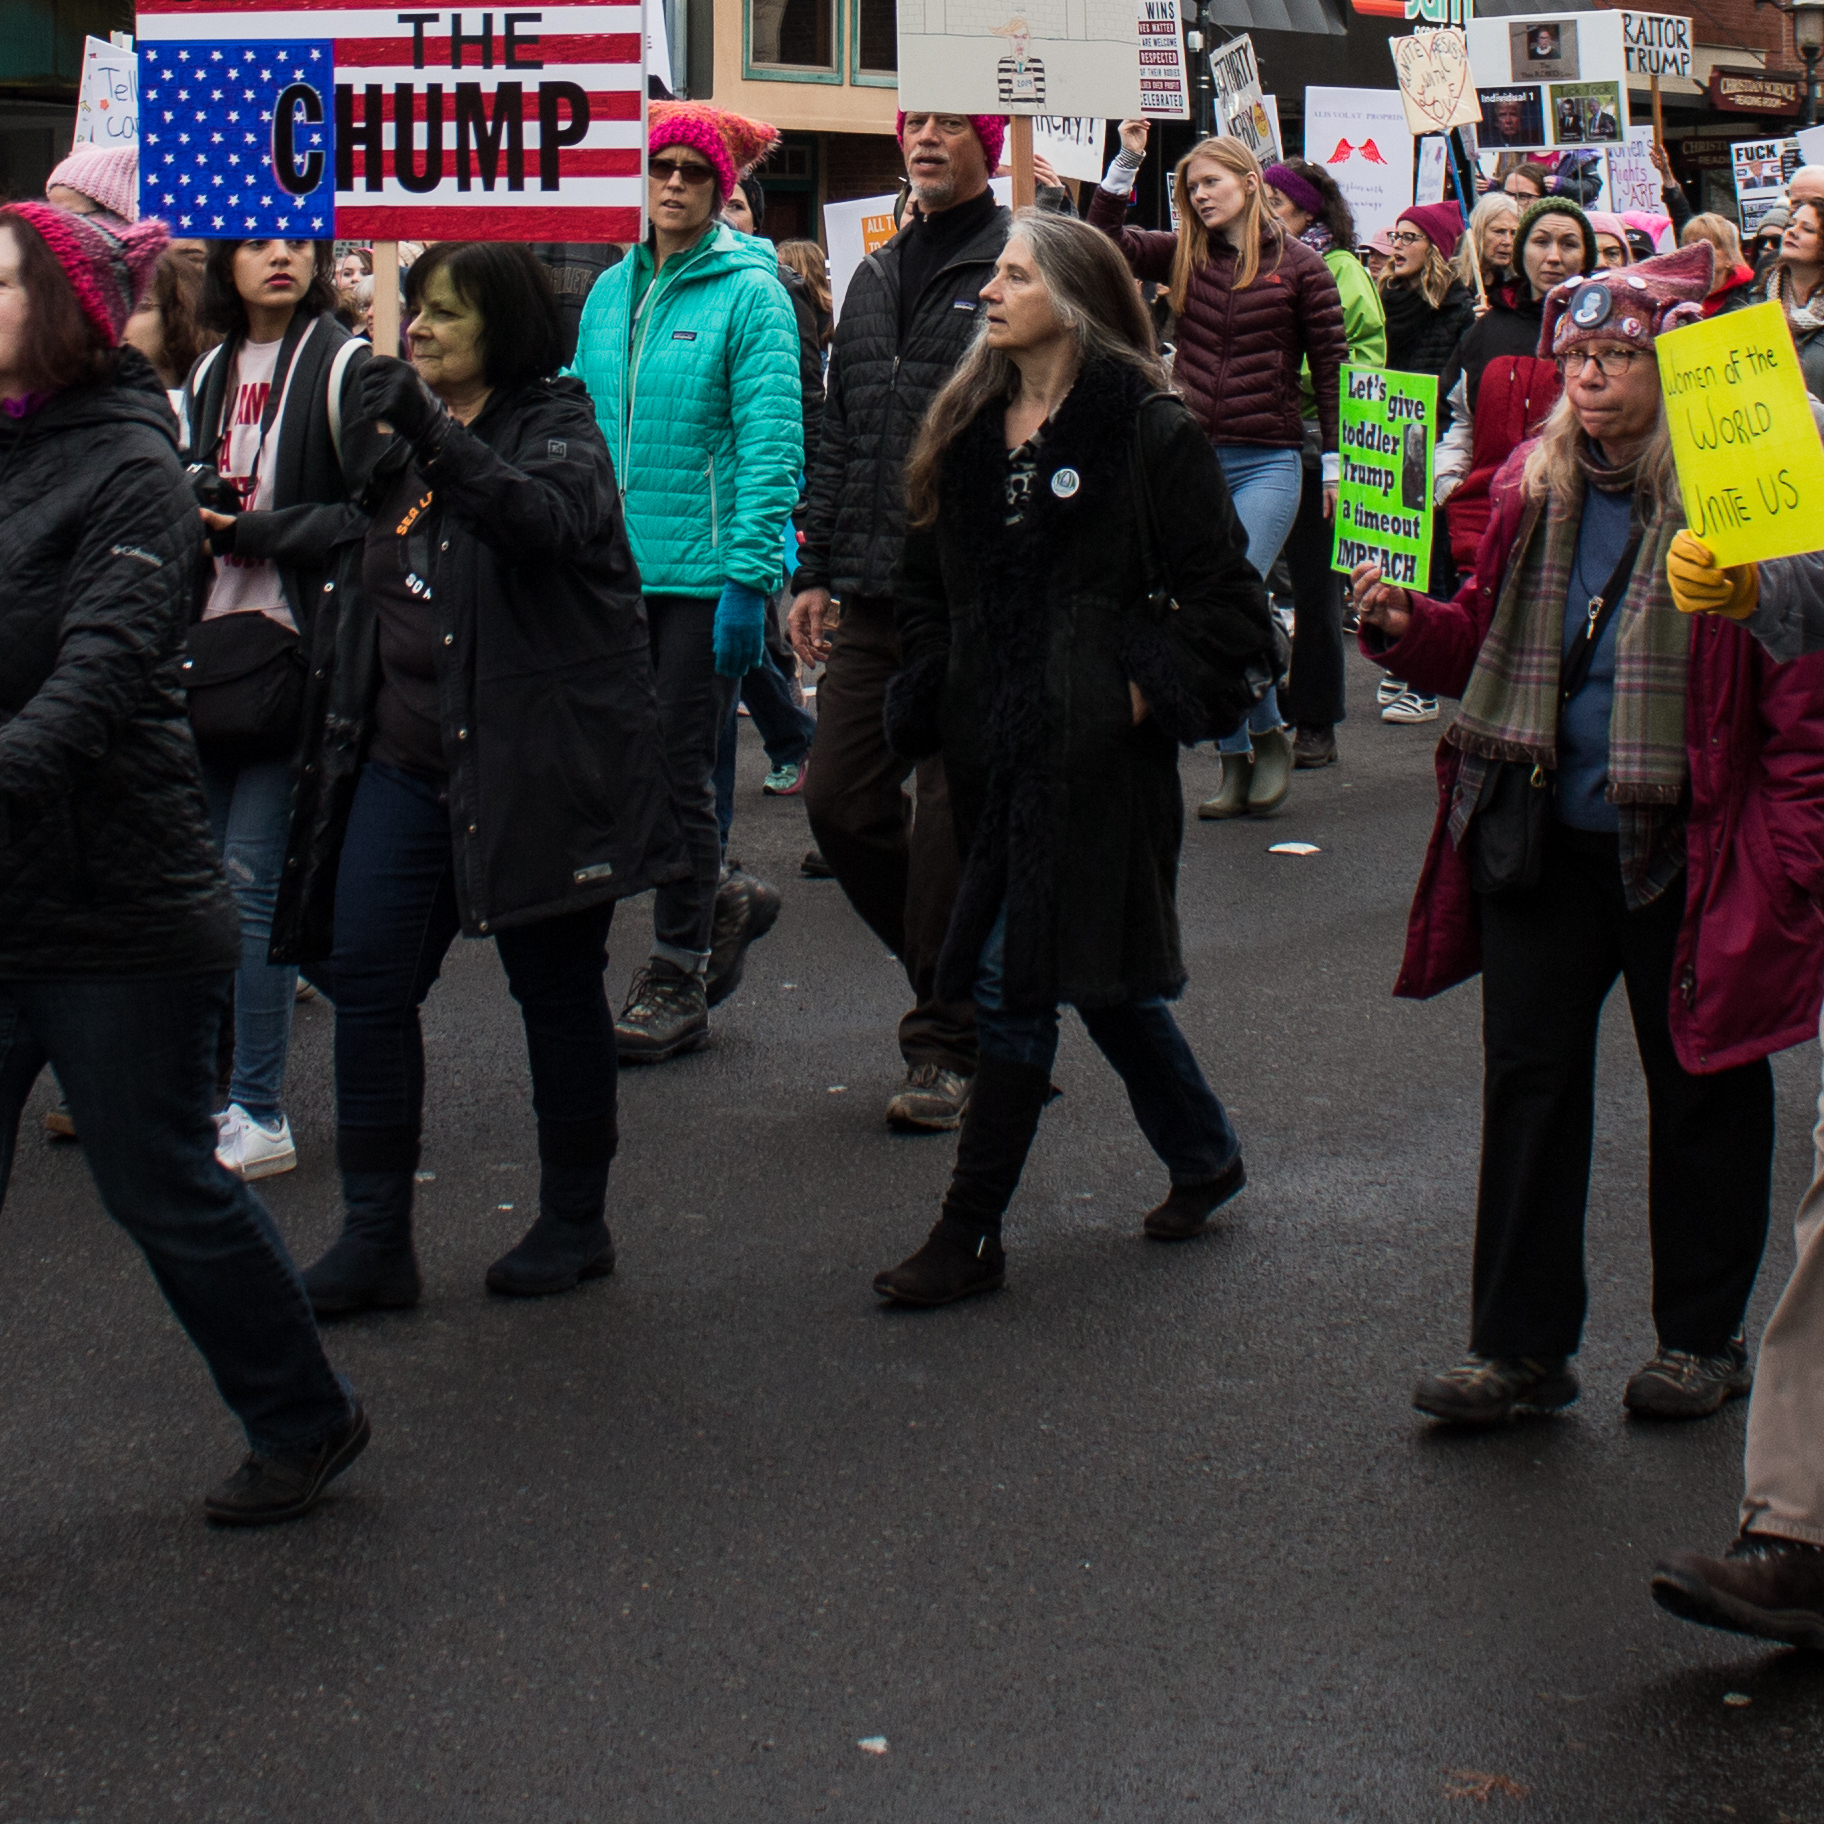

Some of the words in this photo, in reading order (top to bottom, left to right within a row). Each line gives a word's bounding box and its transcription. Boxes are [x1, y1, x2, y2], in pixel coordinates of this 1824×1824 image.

[1145, 1, 1175, 20] WINS
[398, 12, 543, 71] THE
[1621, 12, 1690, 50] RAITOR
[1141, 52, 1177, 64] RESPECTED
[1624, 46, 1691, 76] TRUMP
[1481, 92, 1527, 103] Individual
[1528, 91, 1534, 102] 1
[1558, 85, 1584, 97] Tick
[1586, 83, 1612, 96] Tock
[1333, 112, 1362, 120] VOLAT
[272, 80, 592, 196] CHUMP
[1682, 140, 1729, 155] CHRISTI
[1735, 144, 1778, 163] FUCK
[1698, 155, 1729, 165] READ
[1610, 159, 1647, 195] Rights
[1629, 182, 1659, 210] ARE
[1745, 344, 1778, 375] the
[1348, 370, 1386, 402] Let's
[1387, 388, 1425, 422] give
[1341, 418, 1400, 456] toddler
[1687, 395, 1772, 451] WORLD
[1343, 454, 1394, 497] Trump
[1756, 469, 1799, 516] US
[1342, 499, 1350, 520] a
[1354, 501, 1420, 539] timeout
